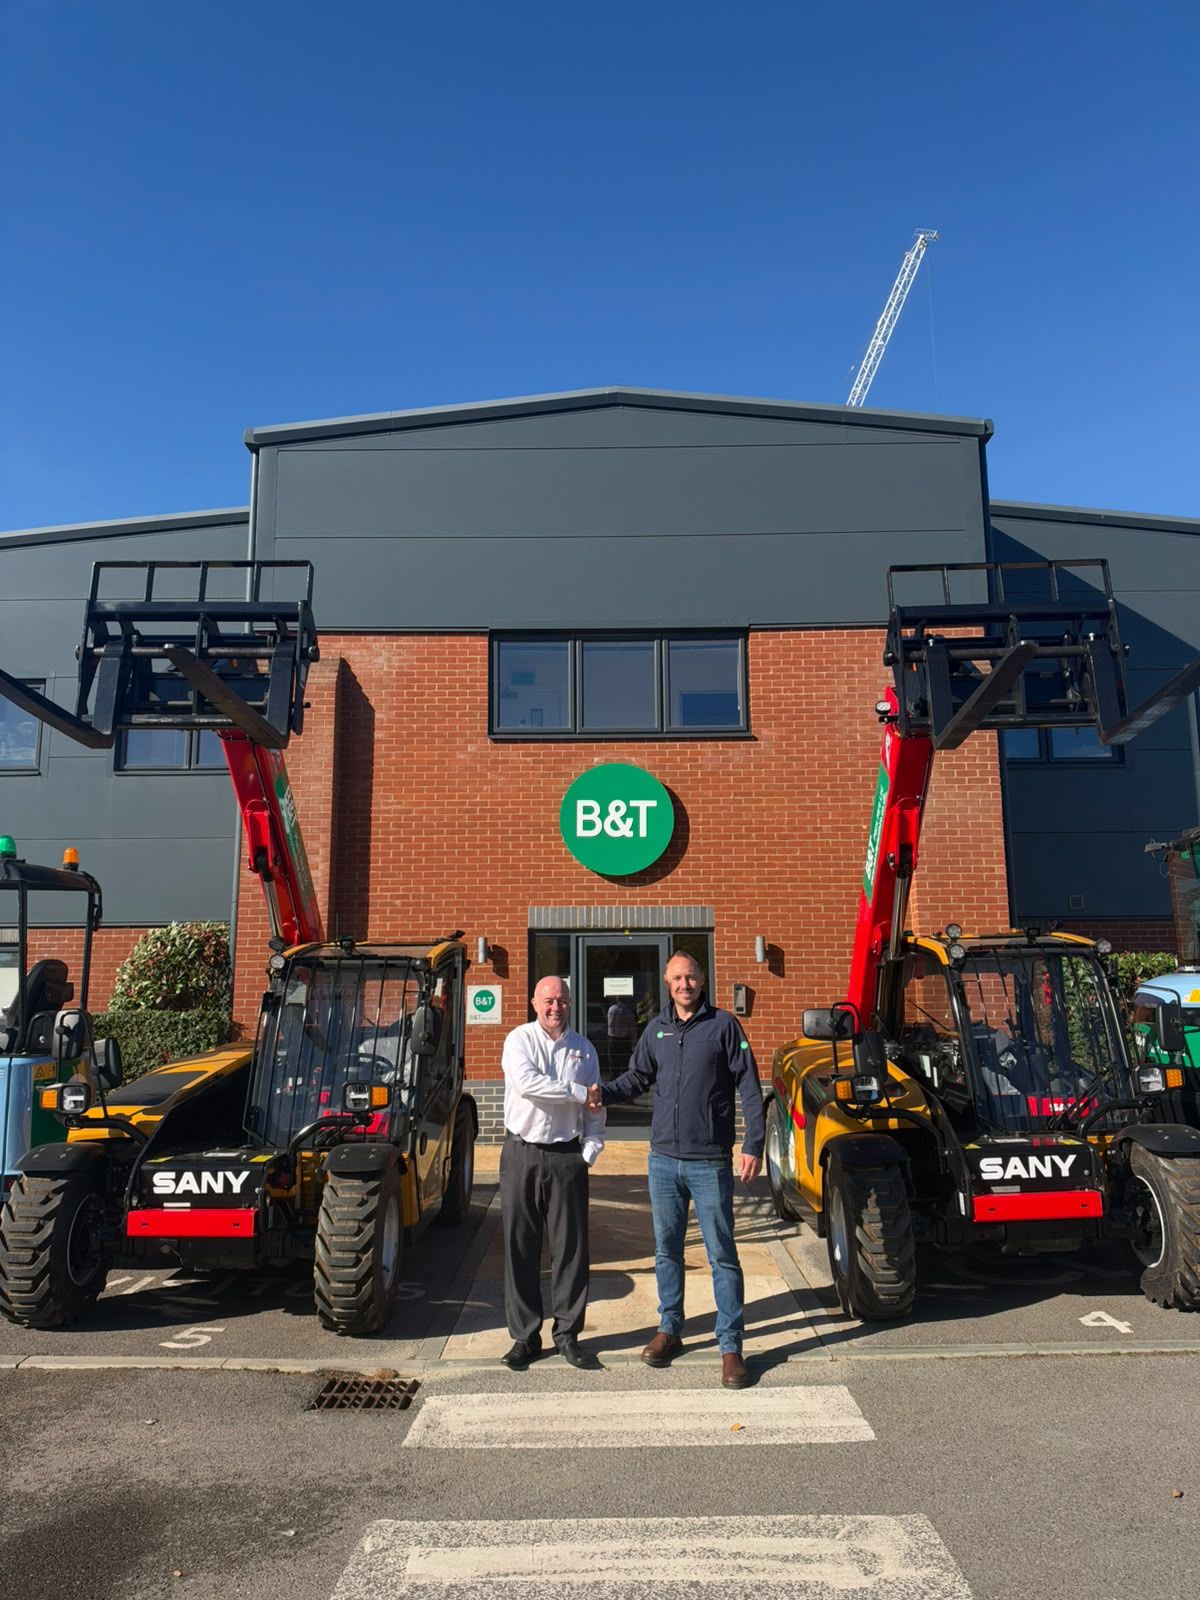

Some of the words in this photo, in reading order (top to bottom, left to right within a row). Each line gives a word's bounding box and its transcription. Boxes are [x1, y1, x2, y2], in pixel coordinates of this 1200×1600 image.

[576, 799, 657, 838] B&T
[475, 996, 494, 1006] B&T
[979, 1154, 1077, 1180] SANY
[152, 1170, 250, 1195] SANY
[1078, 1310, 1134, 1333] 4
[158, 1327, 226, 1349] 5
